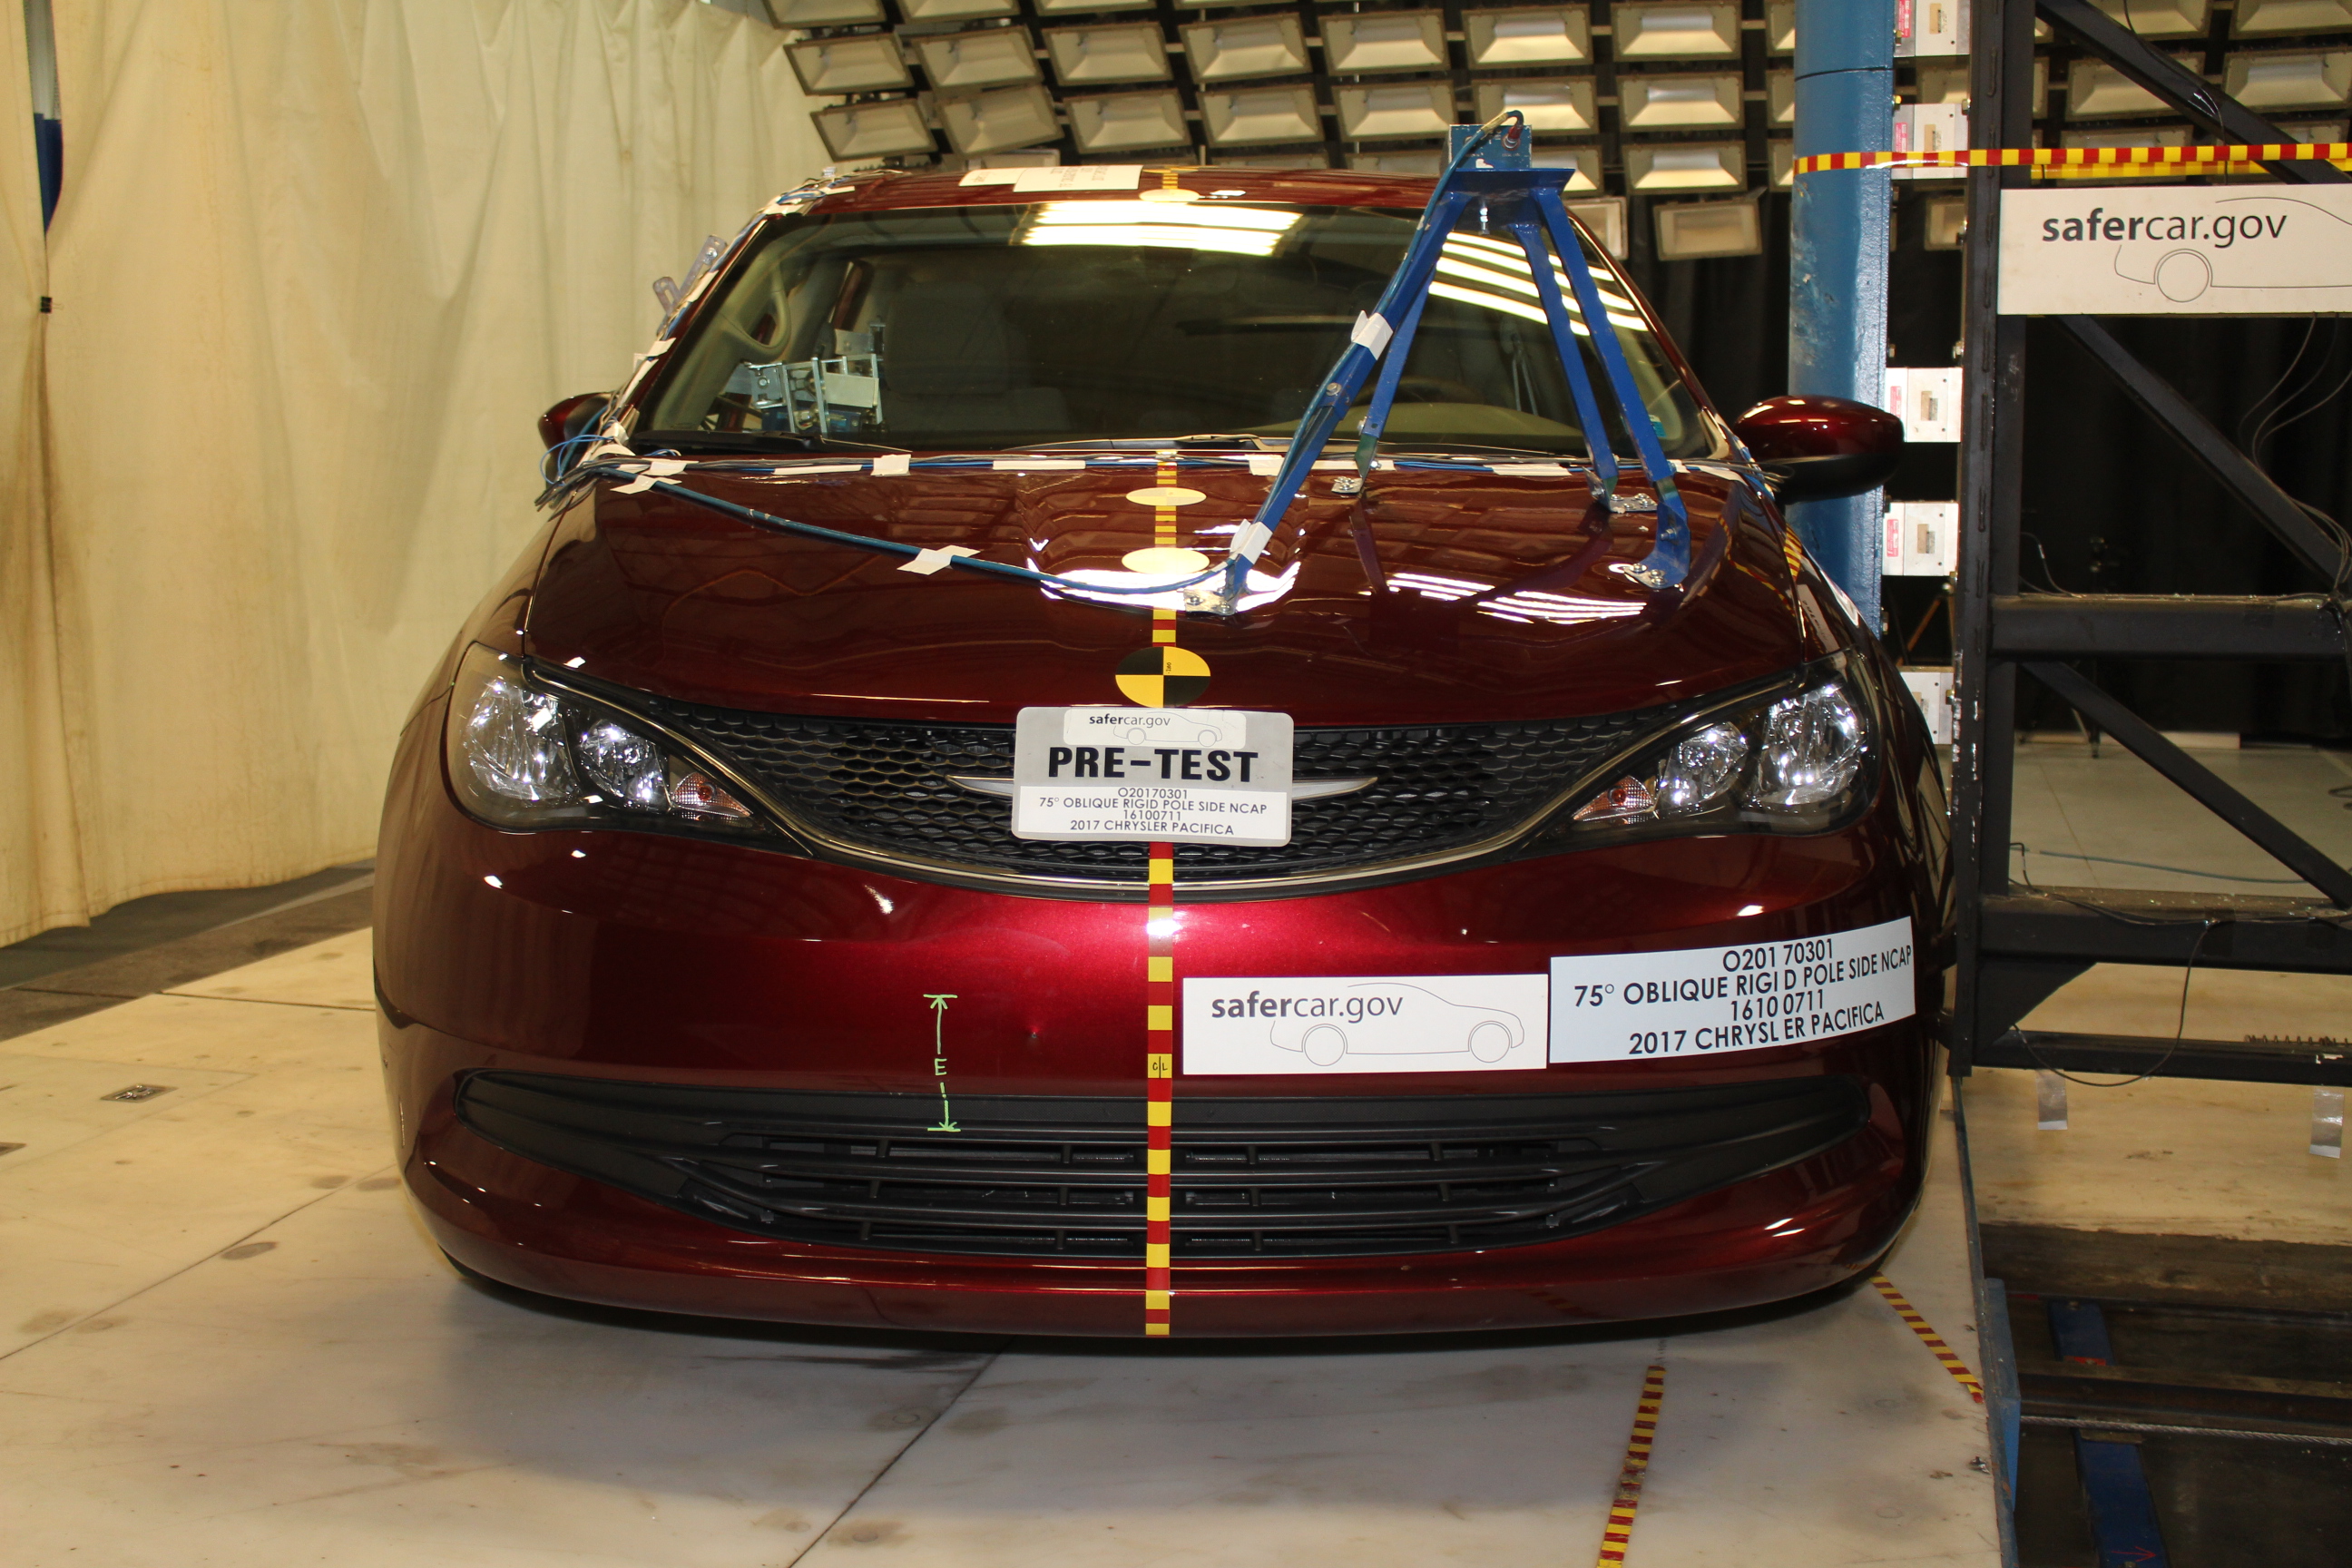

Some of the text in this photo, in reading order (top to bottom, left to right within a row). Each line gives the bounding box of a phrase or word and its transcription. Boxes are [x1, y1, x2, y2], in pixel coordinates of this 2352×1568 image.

[2042, 207, 2288, 249] safercar.gov
[1089, 712, 1171, 728] safercar.gov
[1048, 746, 1259, 782] PRE-TEST
[1038, 796, 1268, 815] 75° OBLIQUE RIGID POLE SIDE NCAP
[1123, 809, 1181, 821] 16100711
[1070, 819, 1234, 836] 2017 CHRYSLER PACIFICA
[1574, 984, 1615, 1007] 75°
[1623, 976, 1728, 1004] OBLIQUE
[1803, 962, 1845, 988] POLE
[1848, 956, 1878, 979] SIDE
[1881, 945, 1912, 973] NCAP
[1211, 990, 1404, 1024] safercar.gov
[1629, 1001, 1885, 1054] 2017 CHRYSLER PACIFICA
[934, 1058, 947, 1076] E
